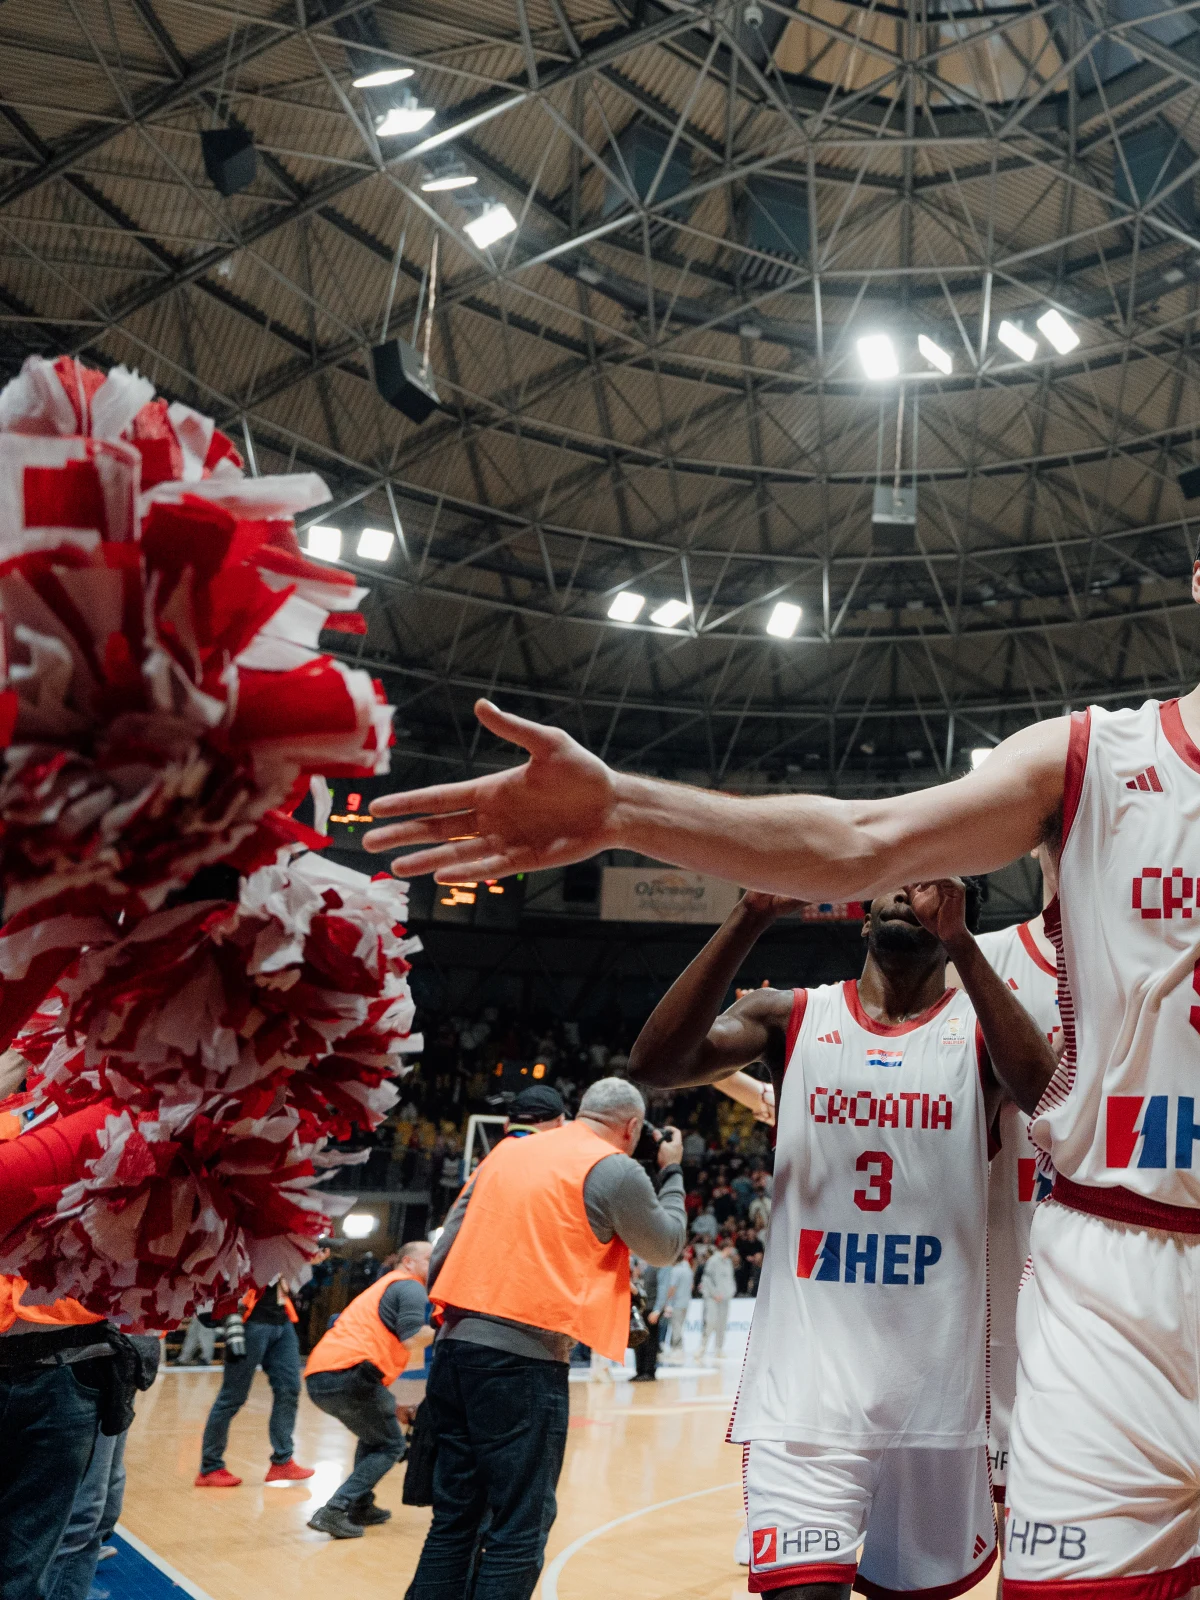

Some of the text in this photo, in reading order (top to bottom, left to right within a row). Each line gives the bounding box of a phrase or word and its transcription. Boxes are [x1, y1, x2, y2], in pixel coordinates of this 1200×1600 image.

[810, 1086, 952, 1130] CROATIA
[853, 1150, 894, 1212] 3
[844, 1233, 942, 1285] HEP
[782, 1529, 841, 1555] HPB
[1009, 1518, 1087, 1561] HPB
